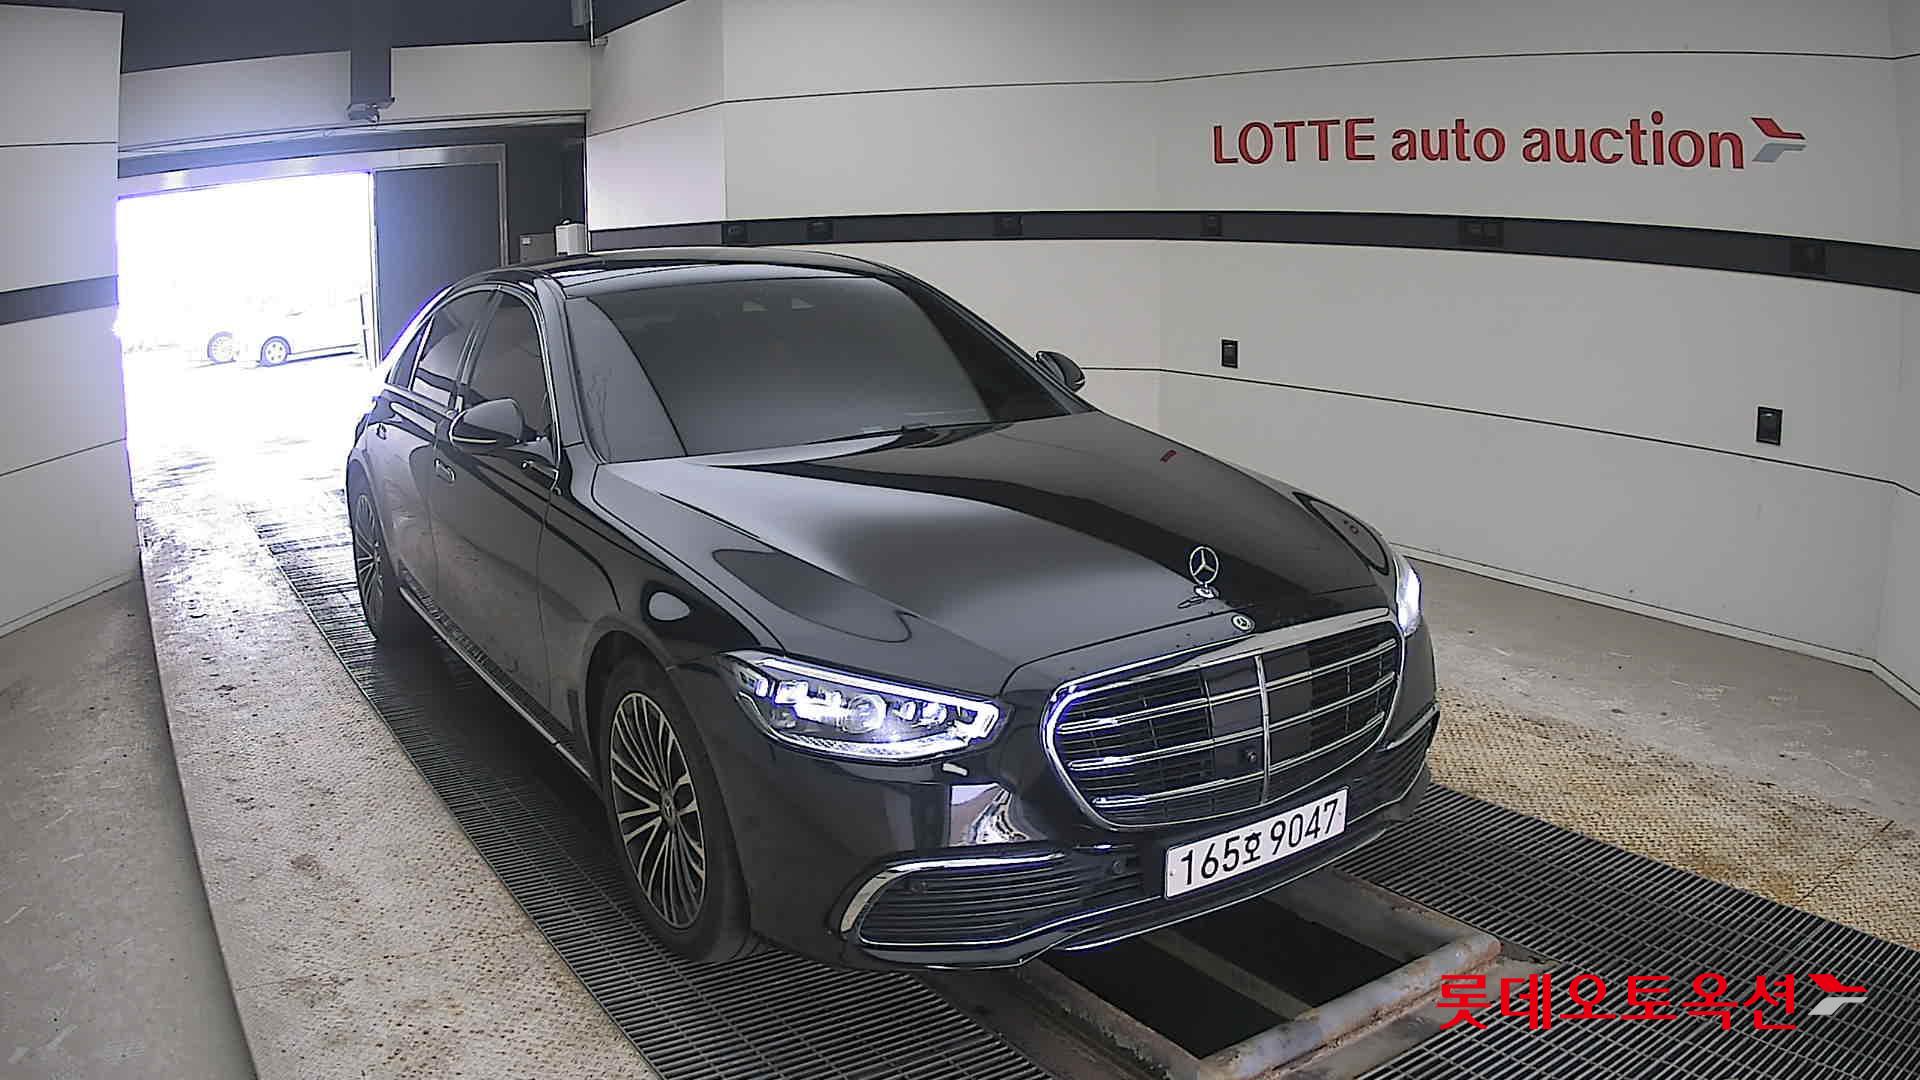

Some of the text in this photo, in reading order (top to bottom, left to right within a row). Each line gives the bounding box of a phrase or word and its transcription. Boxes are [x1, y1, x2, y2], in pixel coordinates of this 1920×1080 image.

[1213, 110, 1745, 170] LOTTE auto auction
[1270, 798, 1339, 855] 9047
